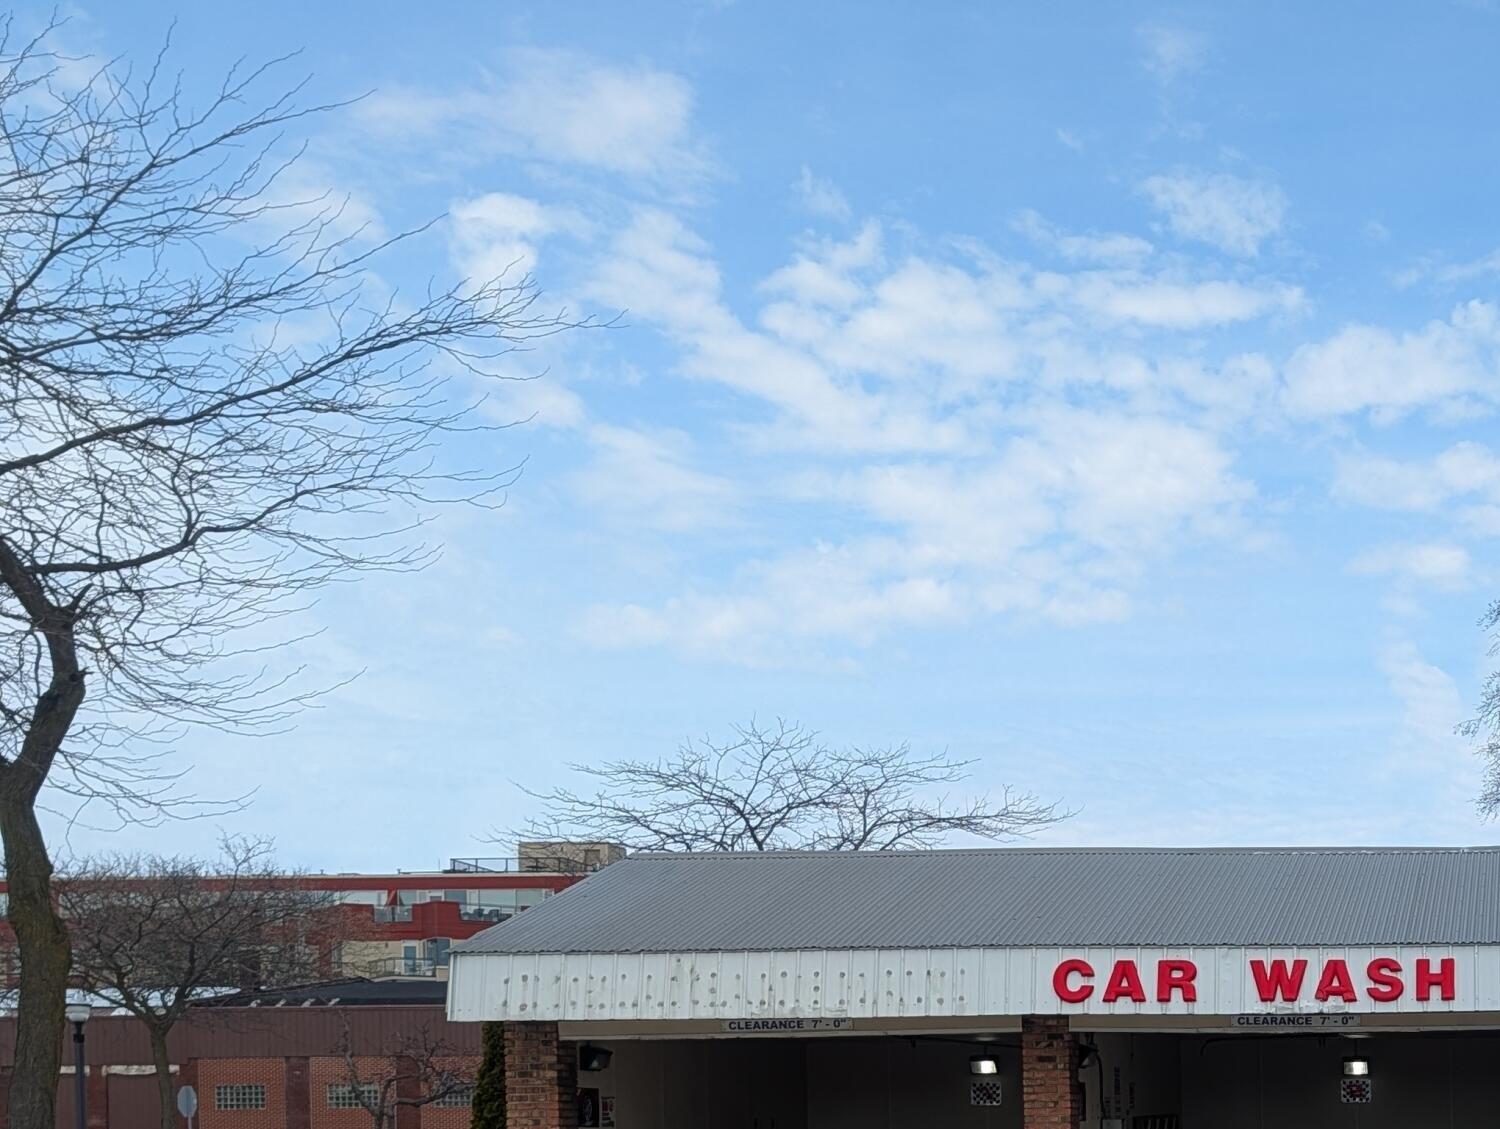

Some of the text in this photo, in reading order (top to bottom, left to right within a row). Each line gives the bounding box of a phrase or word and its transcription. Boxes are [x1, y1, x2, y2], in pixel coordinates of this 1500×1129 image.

[1052, 957, 1456, 1004] CAR WASH
[728, 1019, 805, 1030] CLEARANCE
[1237, 1016, 1313, 1025] CLEARANCE
